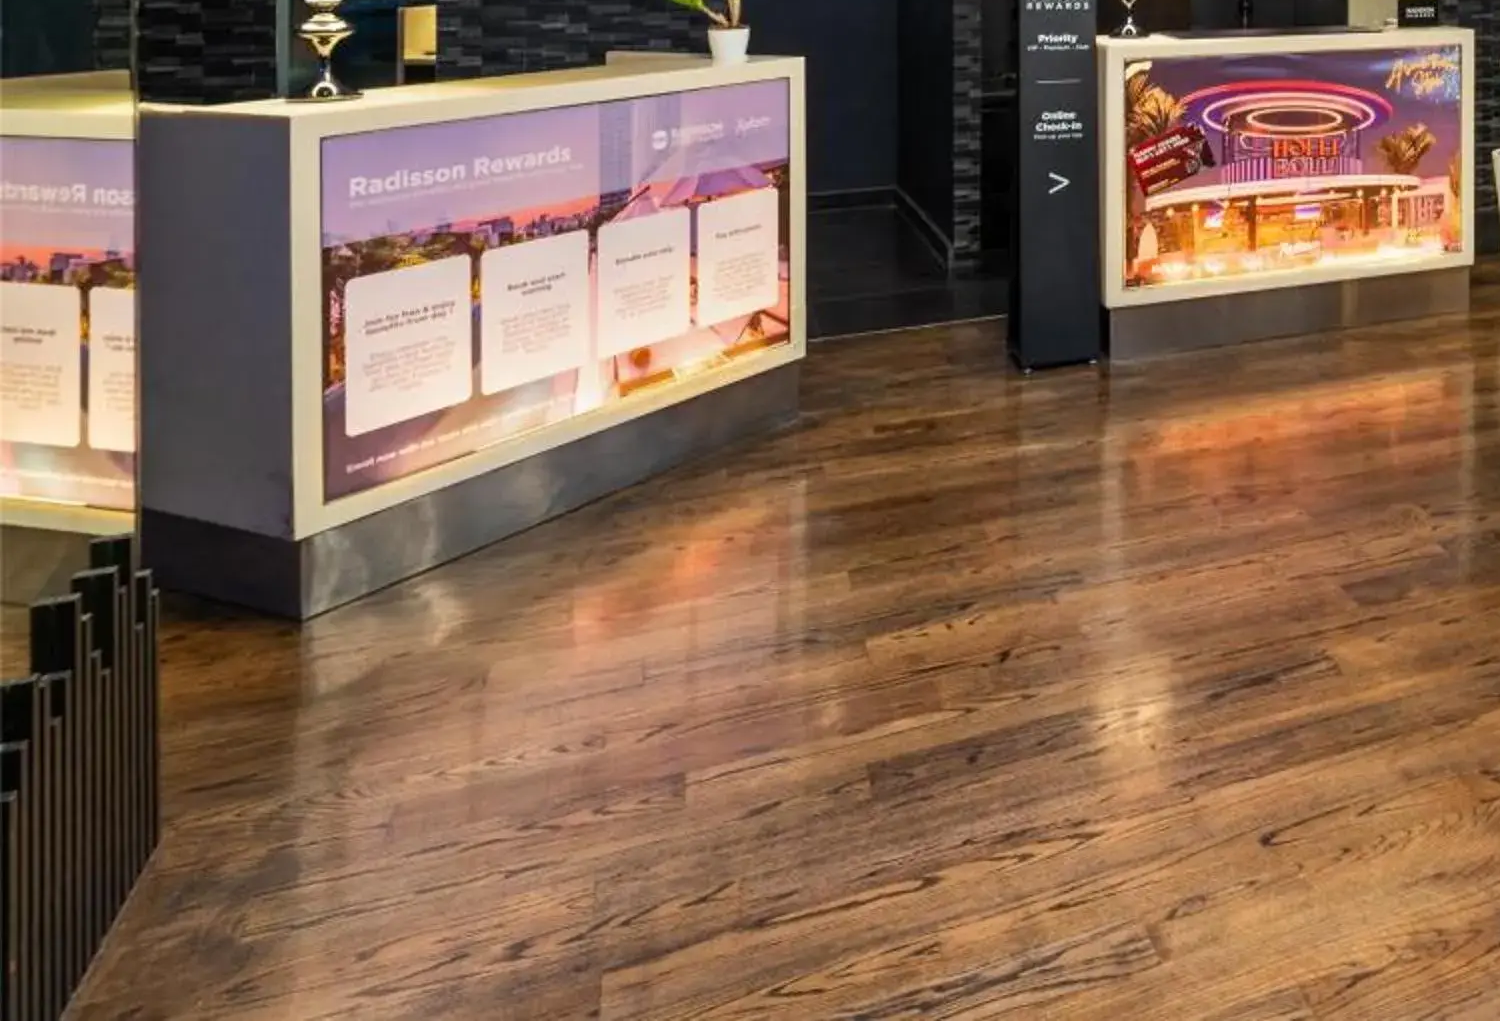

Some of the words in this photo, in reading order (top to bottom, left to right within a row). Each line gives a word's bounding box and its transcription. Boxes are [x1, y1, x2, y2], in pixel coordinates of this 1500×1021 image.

[1026, 1, 1089, 10] REWARDS
[1037, 34, 1079, 44] Priority
[1041, 111, 1077, 121] Online
[1035, 121, 1083, 132] Check-in
[348, 163, 466, 199] Radisson
[473, 145, 572, 178] Rewards
